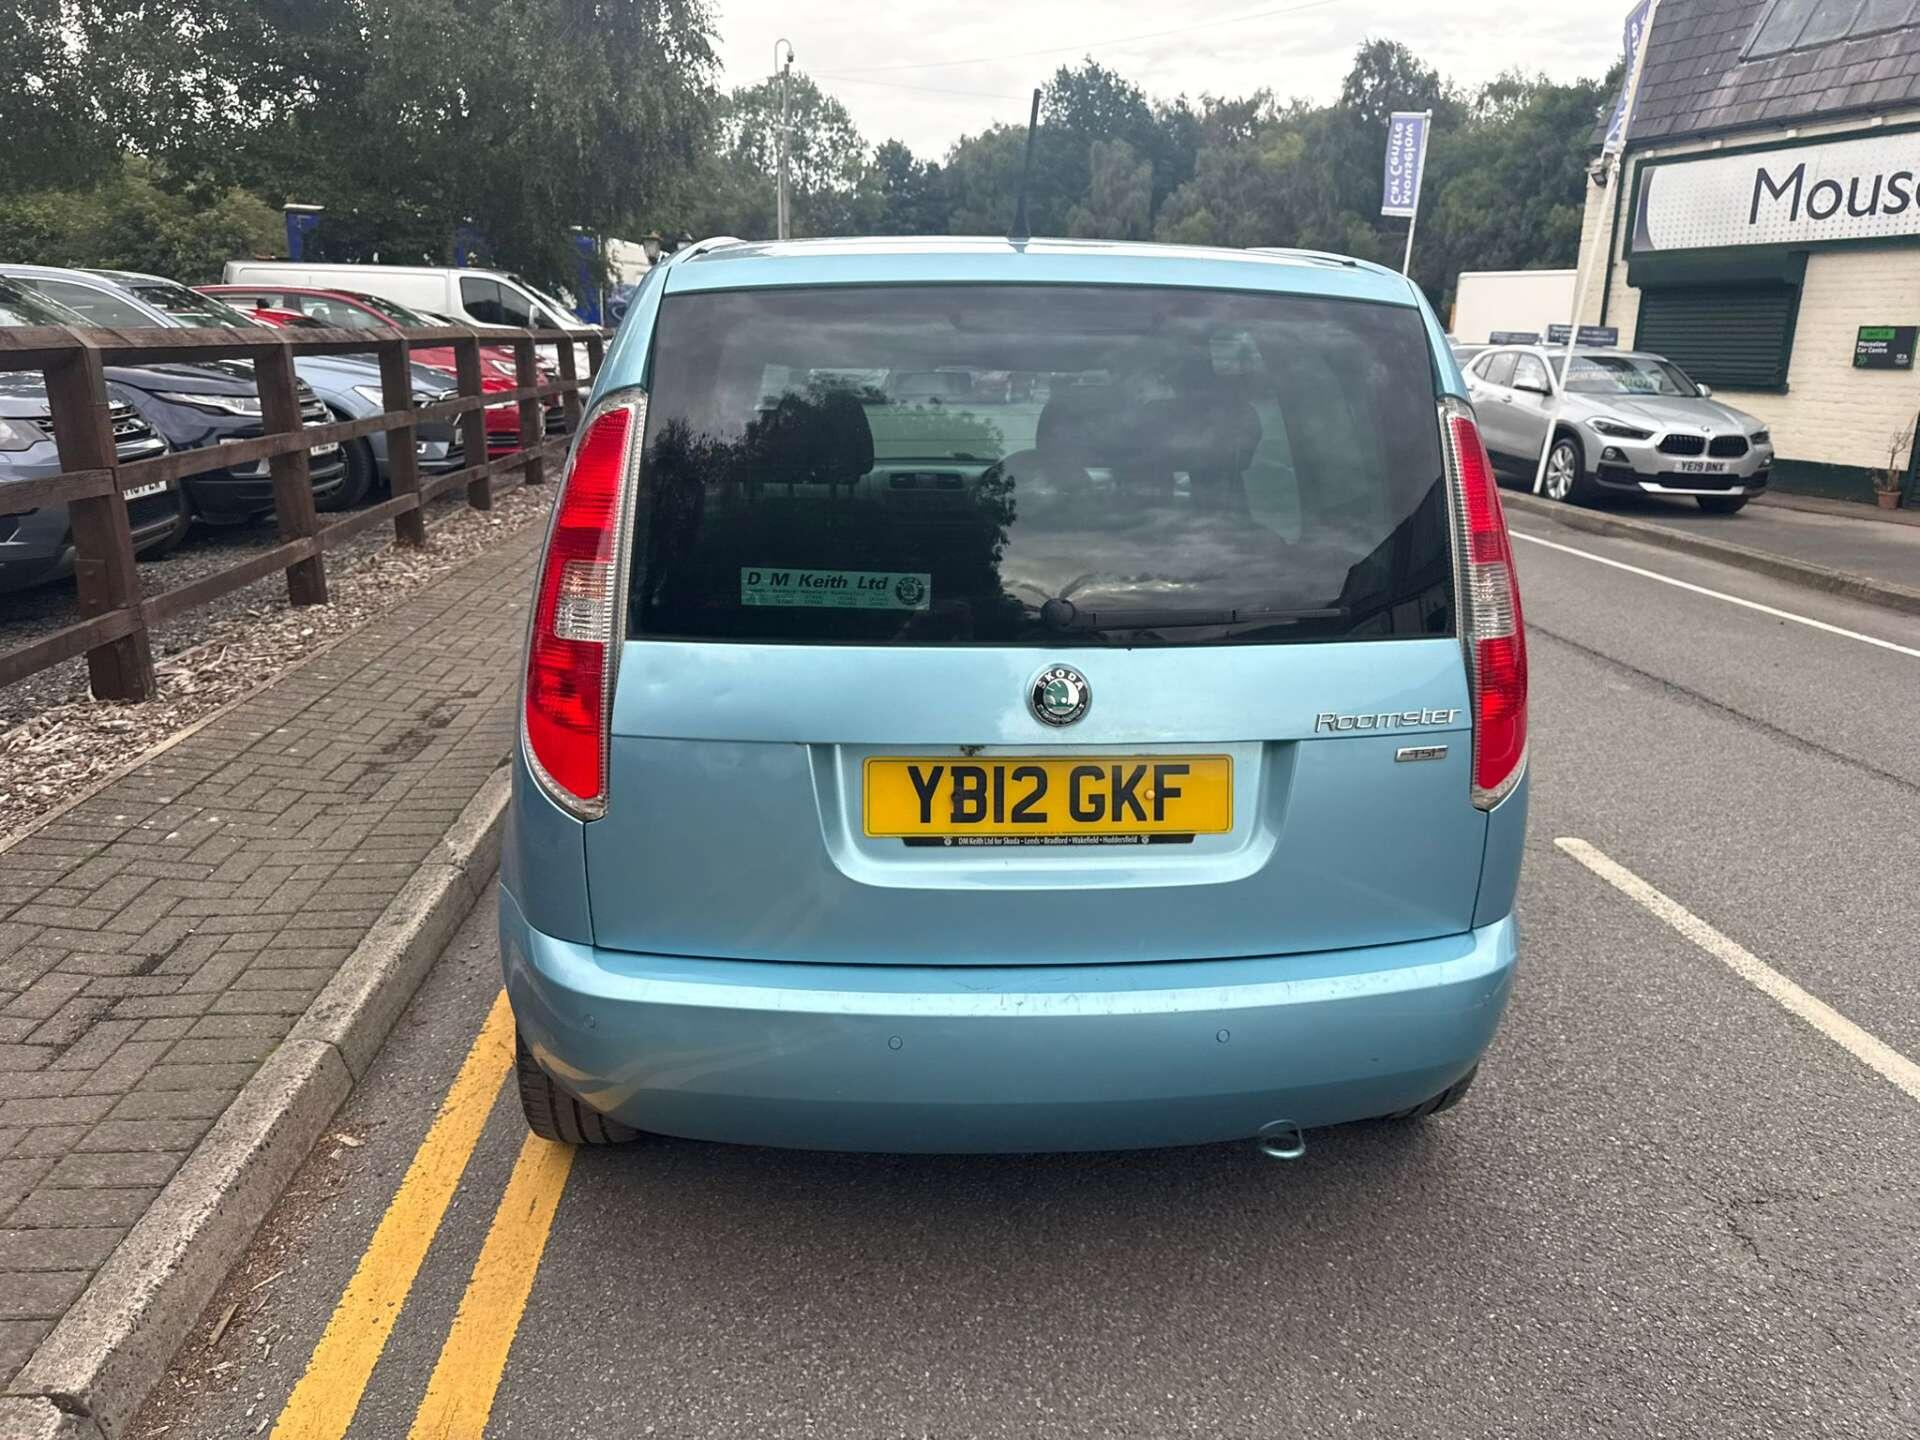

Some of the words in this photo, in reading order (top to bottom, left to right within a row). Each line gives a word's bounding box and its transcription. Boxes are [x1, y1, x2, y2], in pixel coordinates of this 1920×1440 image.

[1749, 162, 1920, 225] Mous
[747, 572, 761, 586] D
[769, 573, 789, 587] M
[799, 574, 848, 588] Keith
[857, 576, 889, 589] Ltd
[1315, 707, 1463, 733] Roomster
[907, 765, 1048, 824] YB12
[1069, 764, 1190, 823] GKF
[969, 836, 984, 845] Keith
[984, 836, 994, 845] Ltd
[1044, 836, 1068, 844] Bradford
[1072, 836, 1099, 844] Wakefield
[1103, 835, 1138, 843] Huddersfield
